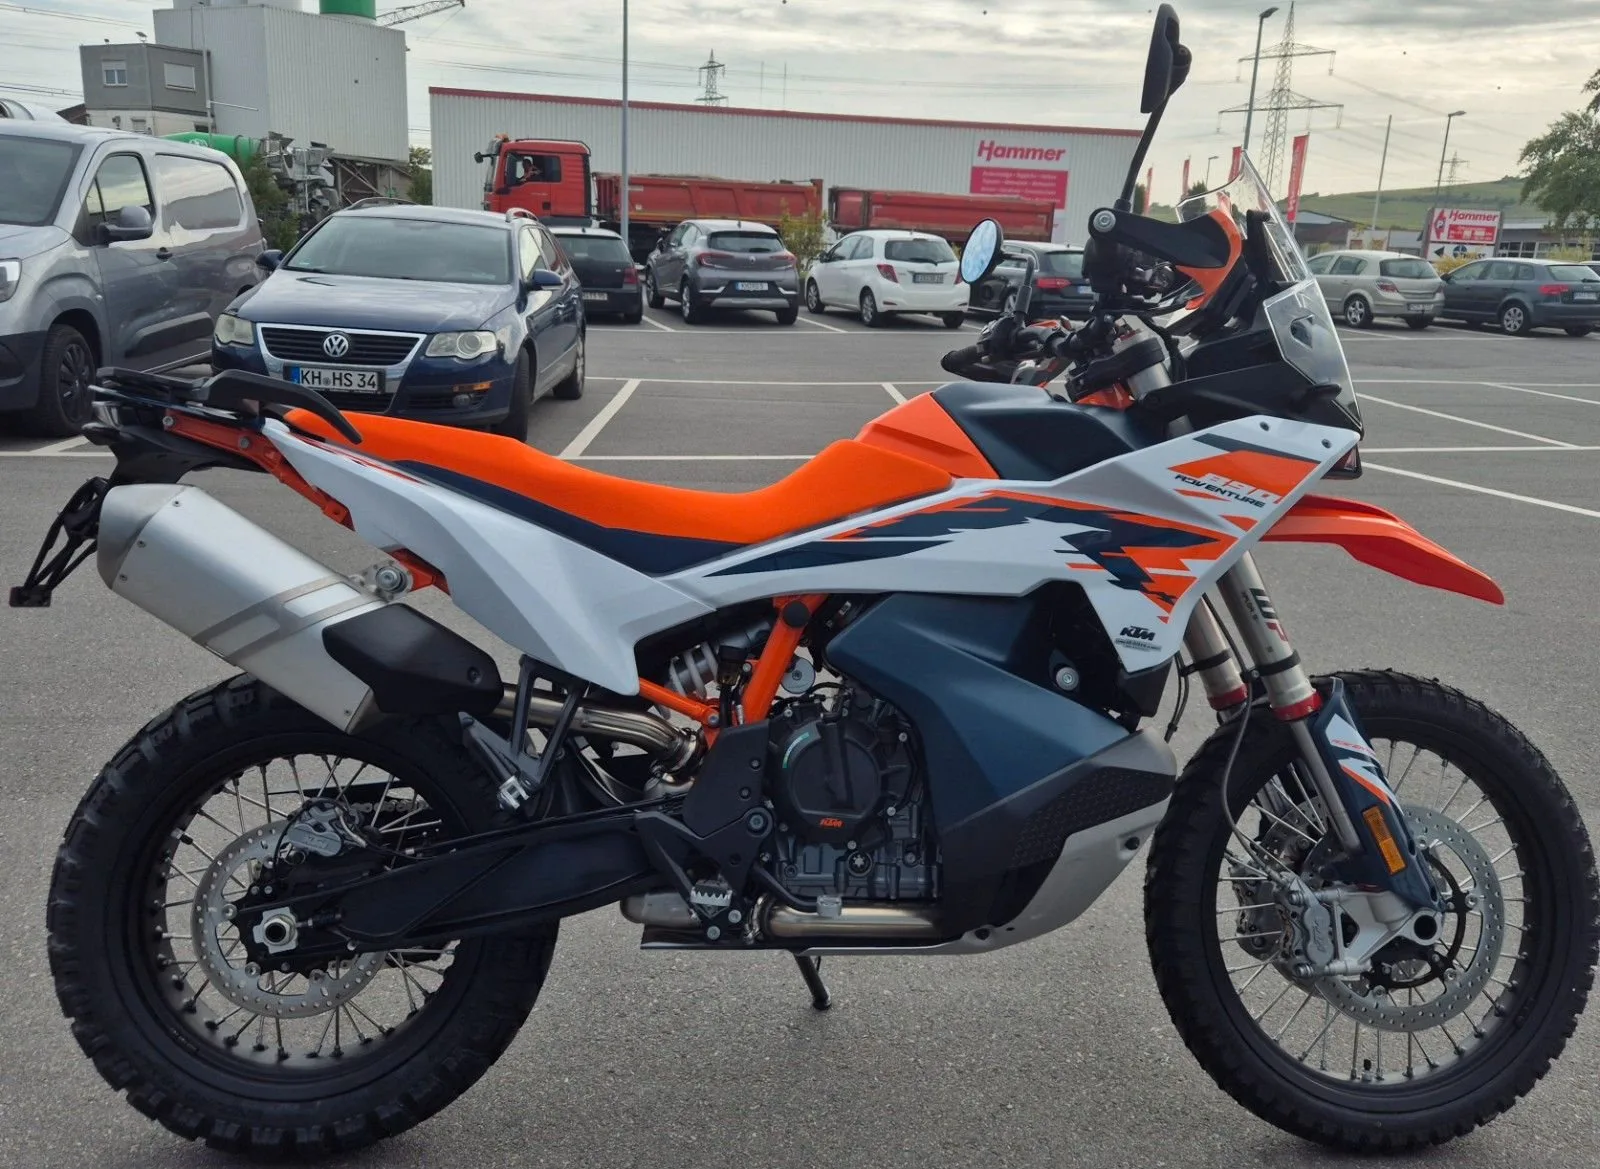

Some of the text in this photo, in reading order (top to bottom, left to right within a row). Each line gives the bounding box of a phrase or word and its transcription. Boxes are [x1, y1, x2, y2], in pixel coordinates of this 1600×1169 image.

[978, 140, 1066, 162] Hammer
[1449, 209, 1498, 222] Hammer
[301, 369, 376, 388] KH HS 34
[1174, 474, 1266, 508] ADVENTURE
[1120, 626, 1156, 641] KTM
[820, 817, 844, 828] KTM
